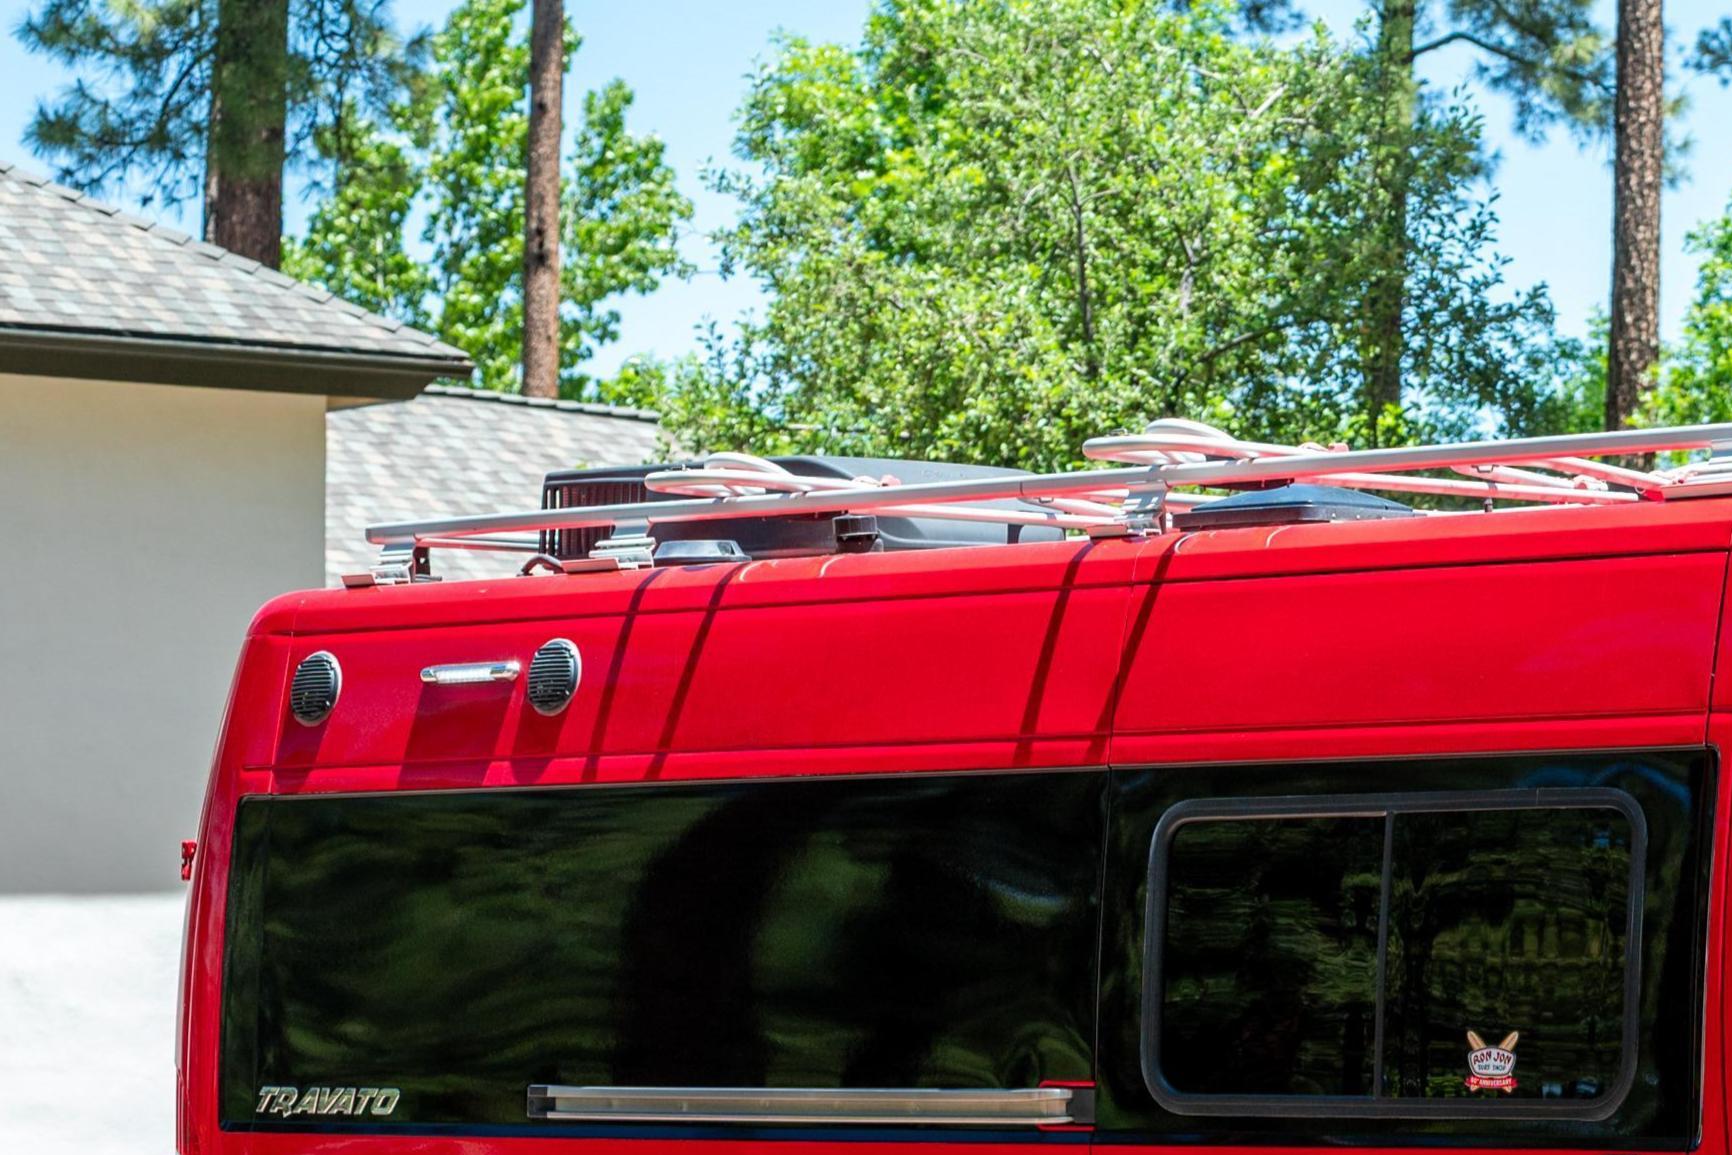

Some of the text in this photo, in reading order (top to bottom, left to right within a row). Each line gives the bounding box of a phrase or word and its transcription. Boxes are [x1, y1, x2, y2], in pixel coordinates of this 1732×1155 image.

[1473, 1050, 1512, 1065] RON JON
[255, 1085, 401, 1118] TRAVATO
